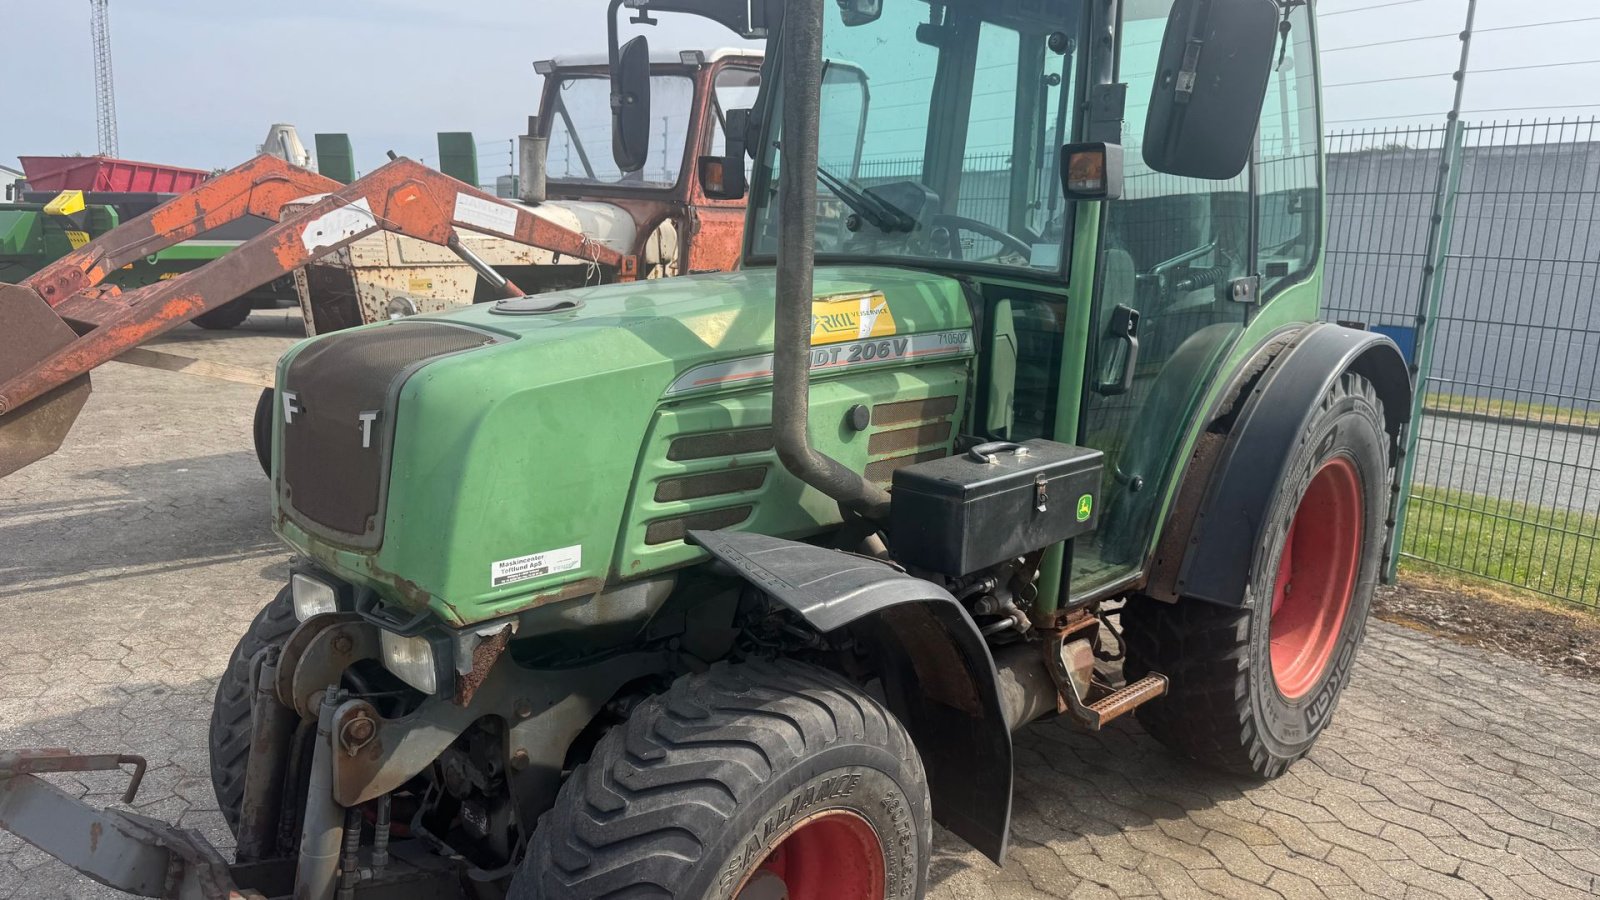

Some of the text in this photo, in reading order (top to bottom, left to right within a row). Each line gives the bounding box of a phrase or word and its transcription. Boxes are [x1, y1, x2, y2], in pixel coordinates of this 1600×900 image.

[938, 332, 968, 345] 710502
[847, 341, 890, 362] 206
[893, 339, 909, 357] V
[282, 390, 380, 448] F T
[499, 554, 545, 569] Maskincenter
[501, 564, 528, 575] Toftlund
[529, 561, 543, 570] ApS
[742, 773, 861, 870] ALLIANCE
